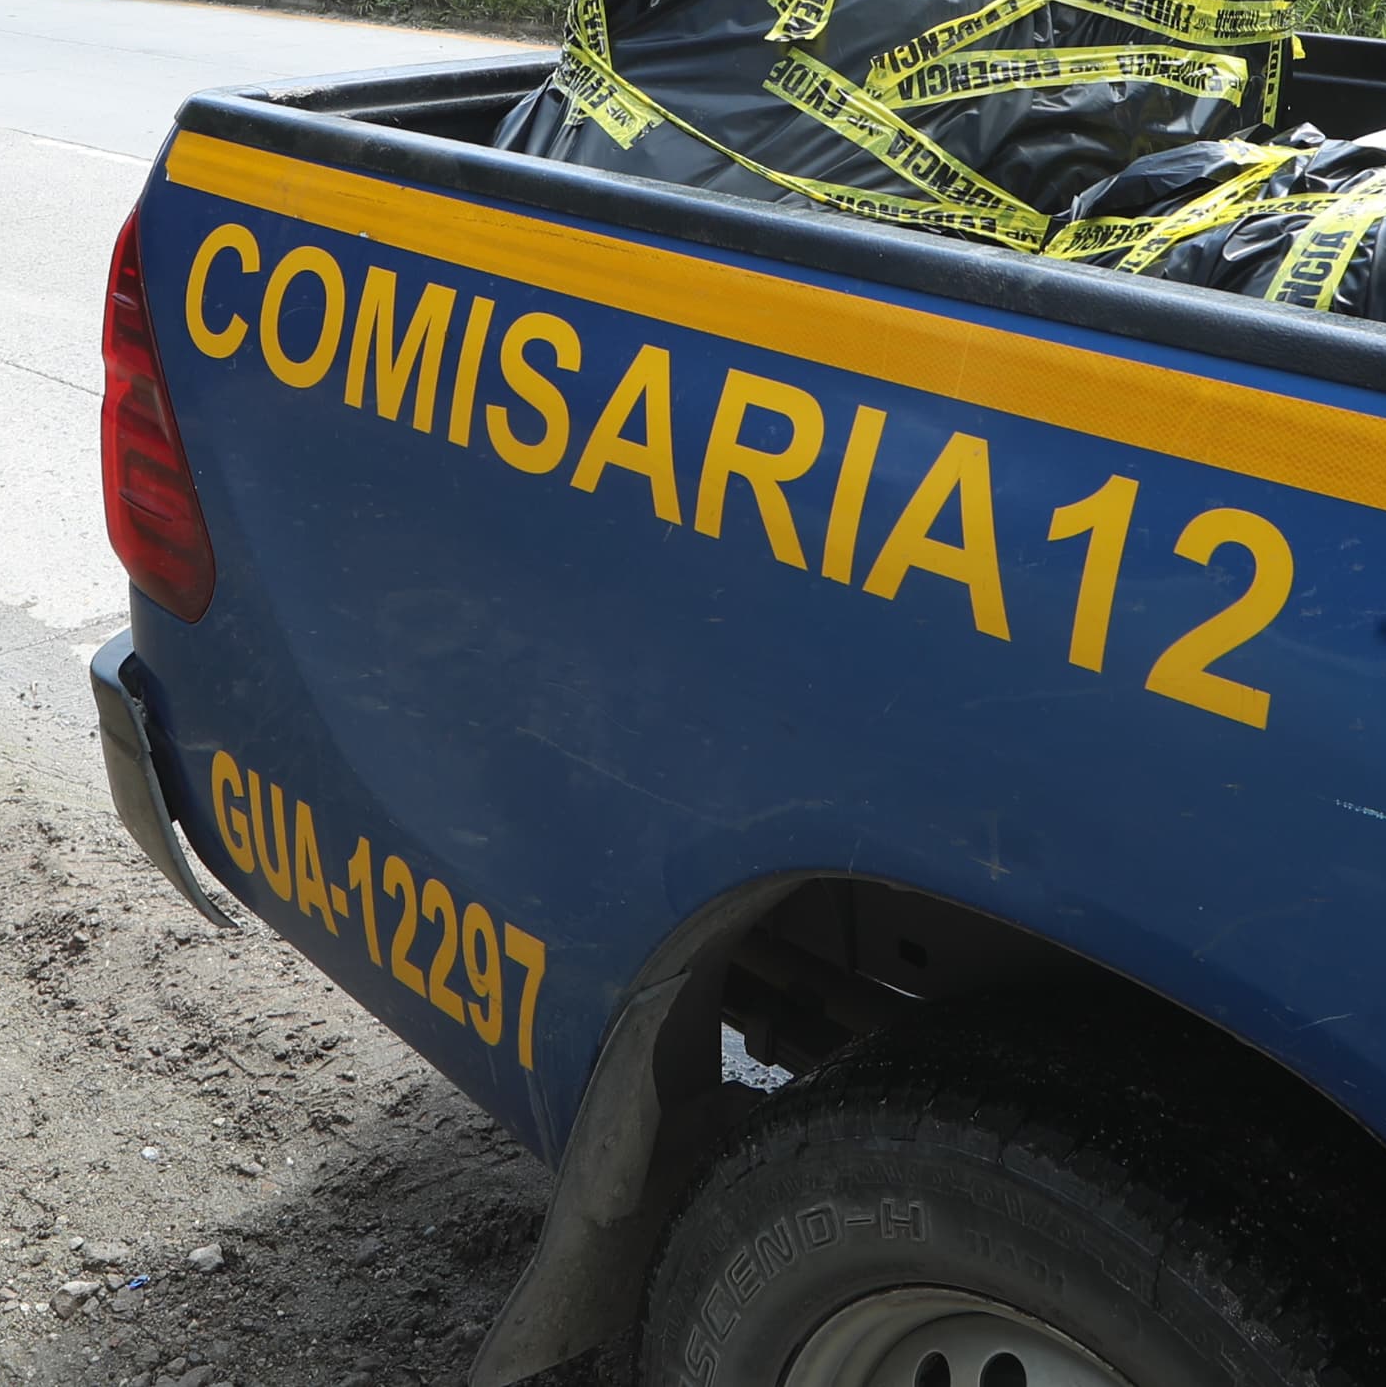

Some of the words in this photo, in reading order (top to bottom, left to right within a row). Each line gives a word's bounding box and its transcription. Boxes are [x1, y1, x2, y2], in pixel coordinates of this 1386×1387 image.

[897, 58, 1062, 101] EVIDENCIA
[184, 221, 1011, 643] COMISARIA
[1045, 474, 1295, 732] 12
[208, 750, 547, 1072] GUA-12297
